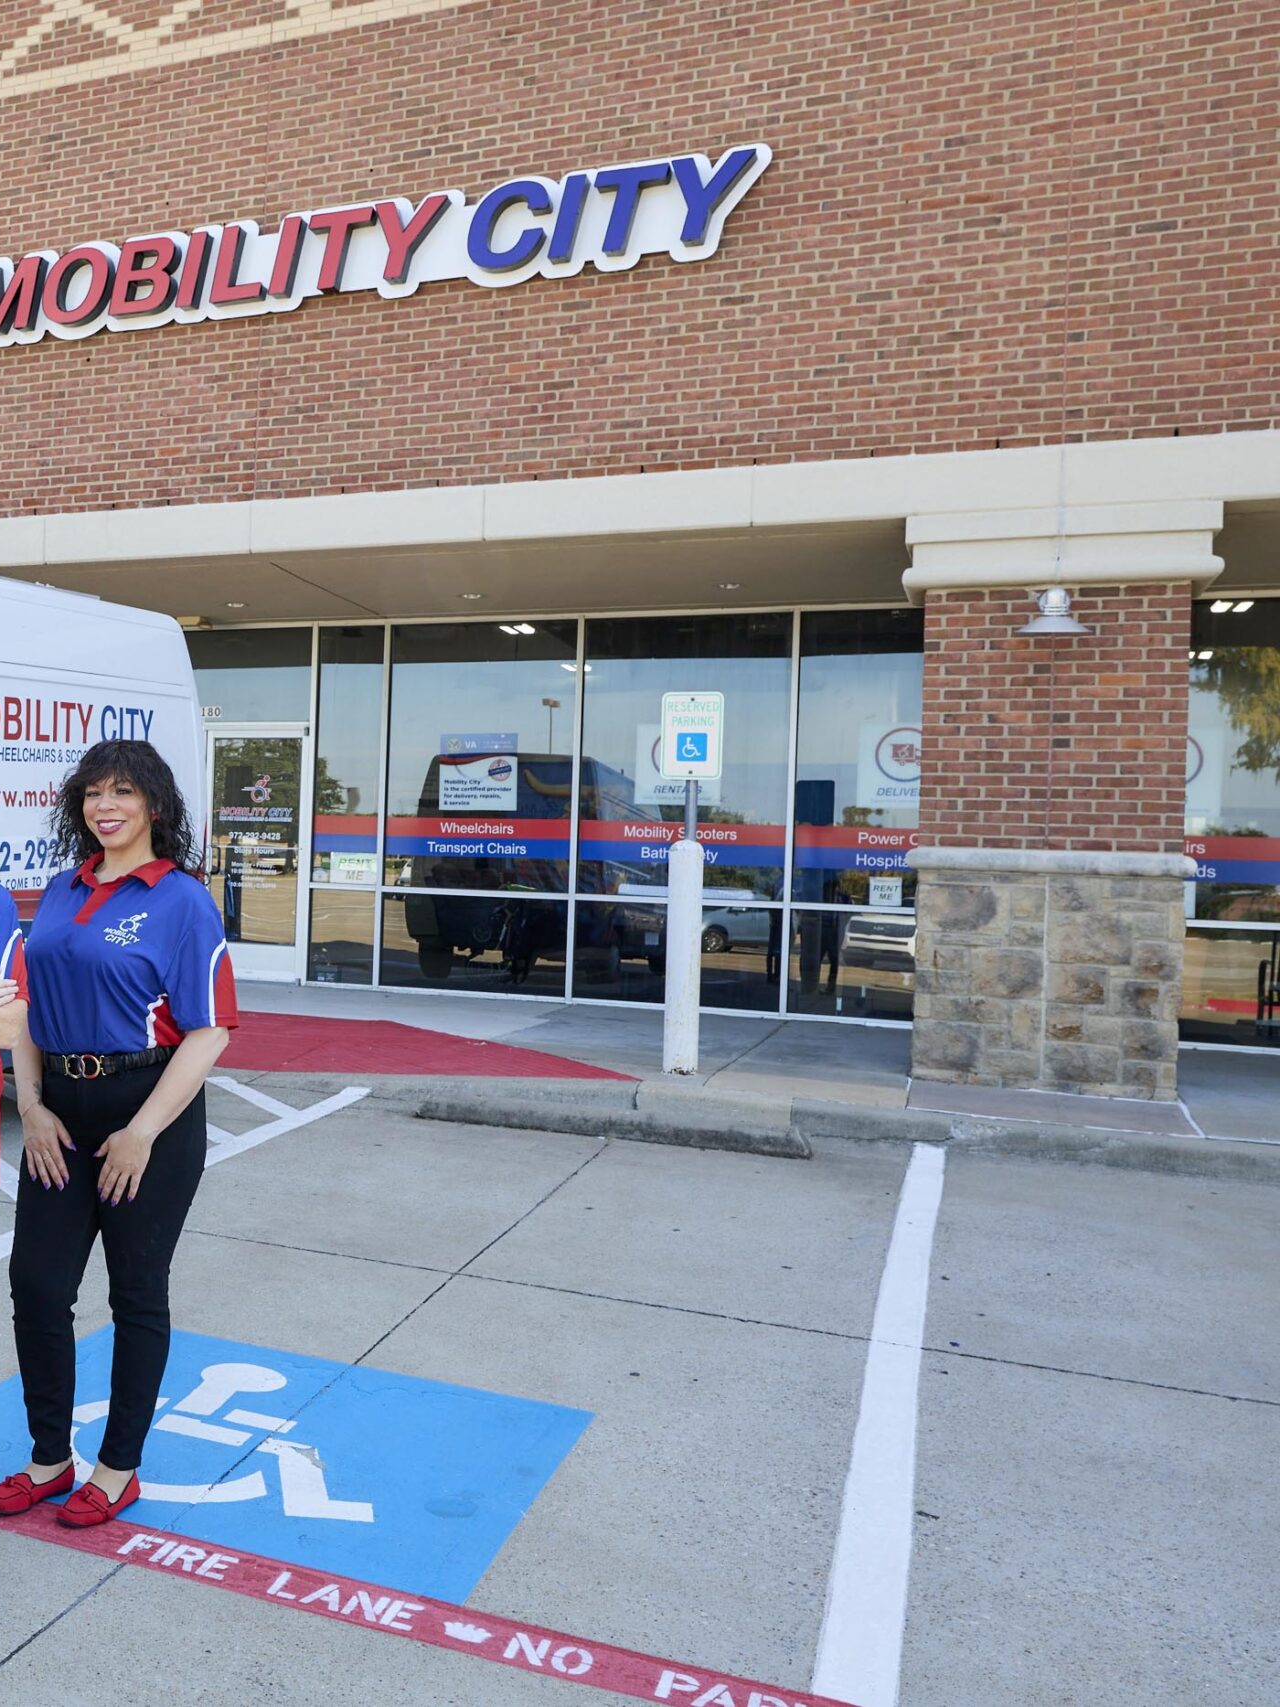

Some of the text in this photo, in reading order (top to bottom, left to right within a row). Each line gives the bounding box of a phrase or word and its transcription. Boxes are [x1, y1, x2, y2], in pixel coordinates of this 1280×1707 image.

[467, 148, 760, 271] CITY
[201, 707, 221, 717] 180
[666, 701, 720, 712] RESERVED
[100, 704, 155, 743] CITY
[671, 716, 714, 726] PARKING
[58, 749, 63, 763] &
[220, 806, 293, 818] MOBILITY CITY
[440, 821, 514, 834] Wheelchairs
[624, 825, 674, 841] Mobility
[857, 831, 905, 846] Power
[427, 841, 527, 856] Transport Chairs
[345, 870, 364, 880] ME
[6, 877, 28, 890] COME
[32, 876, 42, 888] TO
[872, 884, 900, 893] RENT
[878, 893, 893, 901] ME
[103, 927, 141, 943] MOBILITY
[104, 934, 132, 947] CITY
[116, 1533, 240, 1581] FIRE
[267, 1571, 426, 1632] LANE
[503, 1631, 594, 1676] NO
